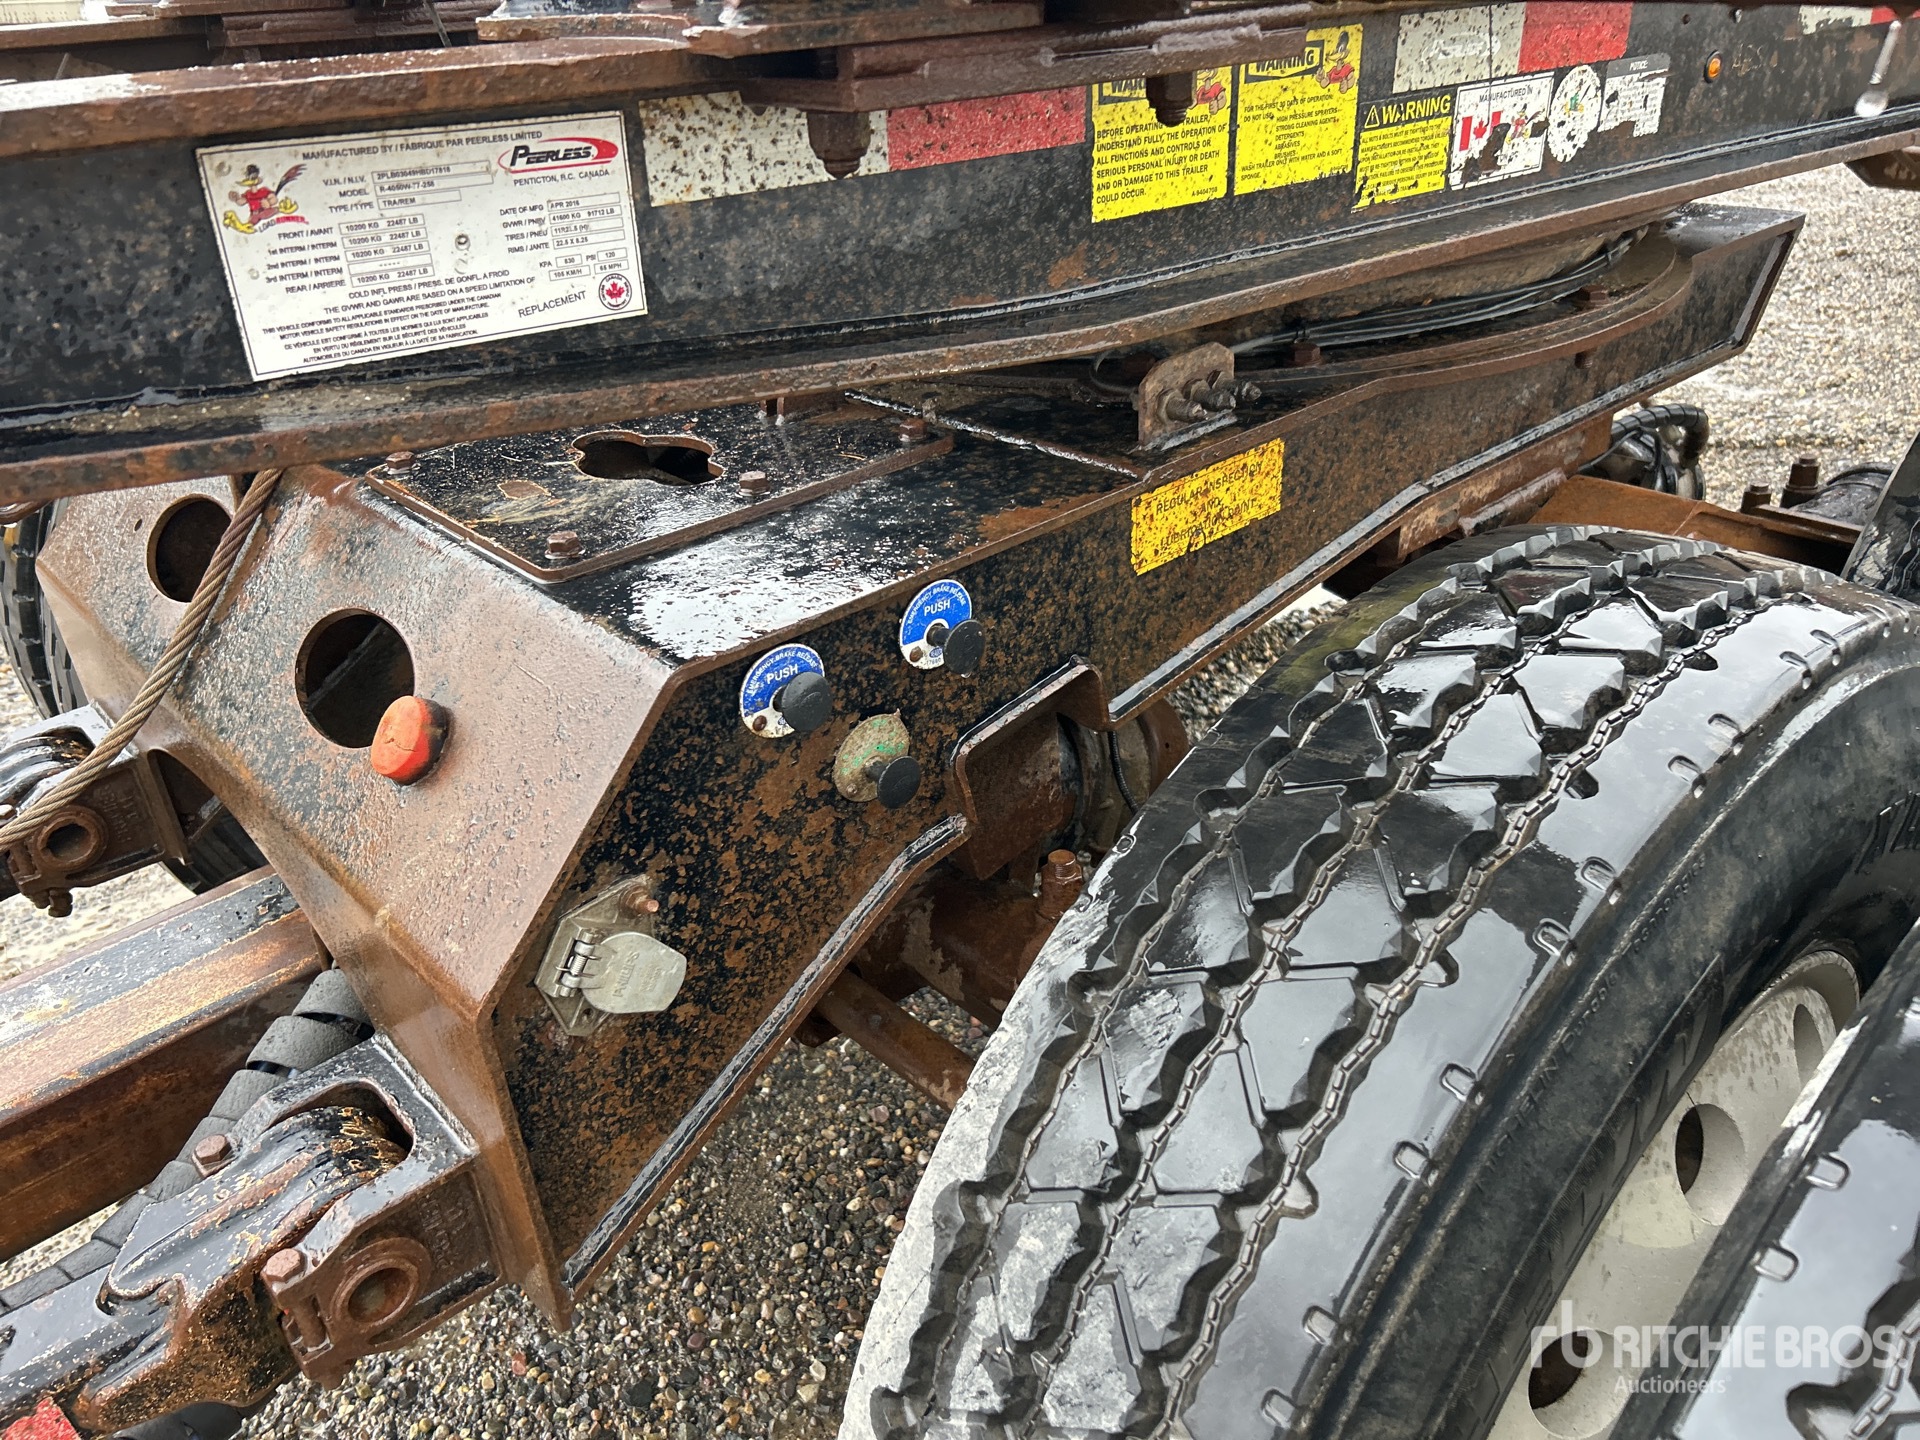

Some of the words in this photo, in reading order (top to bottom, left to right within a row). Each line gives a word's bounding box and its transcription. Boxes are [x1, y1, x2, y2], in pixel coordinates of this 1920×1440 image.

[1479, 88, 1526, 102] MANUFACTURED
[1244, 105, 1254, 113] FOR
[1255, 103, 1265, 111] THE
[1267, 102, 1278, 110] FIRST
[1300, 98, 1306, 106] OF
[1383, 95, 1451, 124] WARNING
[1290, 110, 1314, 120] PRESSURE
[1096, 126, 1123, 139] BEFORE
[1125, 120, 1162, 134] OPERATING
[1276, 123, 1294, 132] STRONG
[1296, 120, 1318, 130] CLEANING
[1096, 137, 1141, 153] UNDERSTAND
[1144, 133, 1164, 145] FULLY,
[1166, 131, 1179, 141] THE
[1180, 125, 1215, 139] OPERATION
[1218, 123, 1226, 133] OF
[1275, 131, 1304, 141] DETERGENTS
[302, 147, 378, 160] MANUFACTURED
[399, 139, 444, 151] FABRIQUE
[446, 138, 463, 147] PAR
[464, 134, 508, 145] PEERLESS
[510, 130, 542, 140] LIMITED
[1096, 155, 1108, 166] ALL
[1110, 149, 1148, 163] FUNCTIONS
[1150, 146, 1164, 156] AND
[1166, 140, 1200, 154] CONTROLS
[1202, 138, 1211, 148] OR
[1275, 141, 1300, 150] ABRASIVES
[510, 145, 592, 166] PEERLESS
[1241, 163, 1255, 172] WASH
[1256, 161, 1275, 170] TRAILER
[1301, 154, 1316, 163] WATER
[1317, 152, 1326, 160] AND
[1096, 165, 1125, 178] SERIOUS
[1128, 159, 1162, 173] PERSONAL
[1164, 155, 1186, 166] INJURY
[1189, 153, 1197, 162] OR
[1200, 149, 1219, 160] DEATH
[578, 168, 609, 178] CANADA
[1096, 181, 1110, 191] AND
[1112, 179, 1122, 188] OR
[1124, 173, 1152, 186] DAMAGE
[1155, 171, 1163, 180] TO
[1166, 169, 1179, 178] THIS
[1182, 164, 1208, 176] TRAILER
[338, 188, 369, 198] MODEL
[1096, 192, 1118, 204] COULD
[1121, 187, 1146, 199] OCCUR.
[328, 204, 349, 213] TYPE
[353, 201, 374, 210] TYPE
[382, 197, 416, 207] TRA/REM
[499, 207, 516, 215] DATE
[528, 204, 544, 212] MFG
[345, 223, 367, 231] 10200
[386, 218, 406, 226] 22487
[502, 220, 523, 228] GVWR
[277, 230, 304, 240] FRONT
[308, 227, 334, 236] AVANT
[348, 237, 370, 245] 10200
[388, 232, 409, 240] 22487
[505, 232, 524, 240] TIRES
[529, 229, 548, 237] PNEU
[279, 245, 306, 254] INTERM
[310, 241, 337, 250] INTERM
[351, 250, 372, 258] 10200
[391, 245, 411, 253] 22487
[528, 242, 549, 250] JANTE
[280, 259, 307, 268] INTERM
[314, 254, 340, 263] INTERM
[538, 260, 552, 268] KPA
[278, 271, 310, 281] INTERM
[313, 267, 343, 276] INTERM
[356, 275, 377, 283] 10200
[396, 269, 416, 278] 22487
[565, 268, 582, 276] KM/H
[285, 285, 307, 294] REAR
[312, 279, 346, 290] ARRIERE
[348, 290, 369, 299] COLD
[387, 283, 412, 293] PRESS
[444, 277, 455, 285] DE
[488, 269, 509, 278] FROID
[324, 306, 339, 314] THE
[340, 302, 365, 312] GVWR
[364, 299, 381, 308] AND
[382, 296, 405, 305] GAWR
[405, 294, 420, 302] ARE
[421, 290, 445, 299] BASED
[446, 288, 458, 296] ON
[464, 283, 488, 293] SPEED
[488, 278, 525, 289] LIMITATION
[518, 290, 587, 318] REPLACEMENT
[1156, 488, 1201, 516] REGULAR
[1205, 461, 1262, 492] INSPECTION
[1200, 498, 1222, 514] AND
[924, 599, 950, 616] PUSH
[766, 663, 798, 684] PUSH
